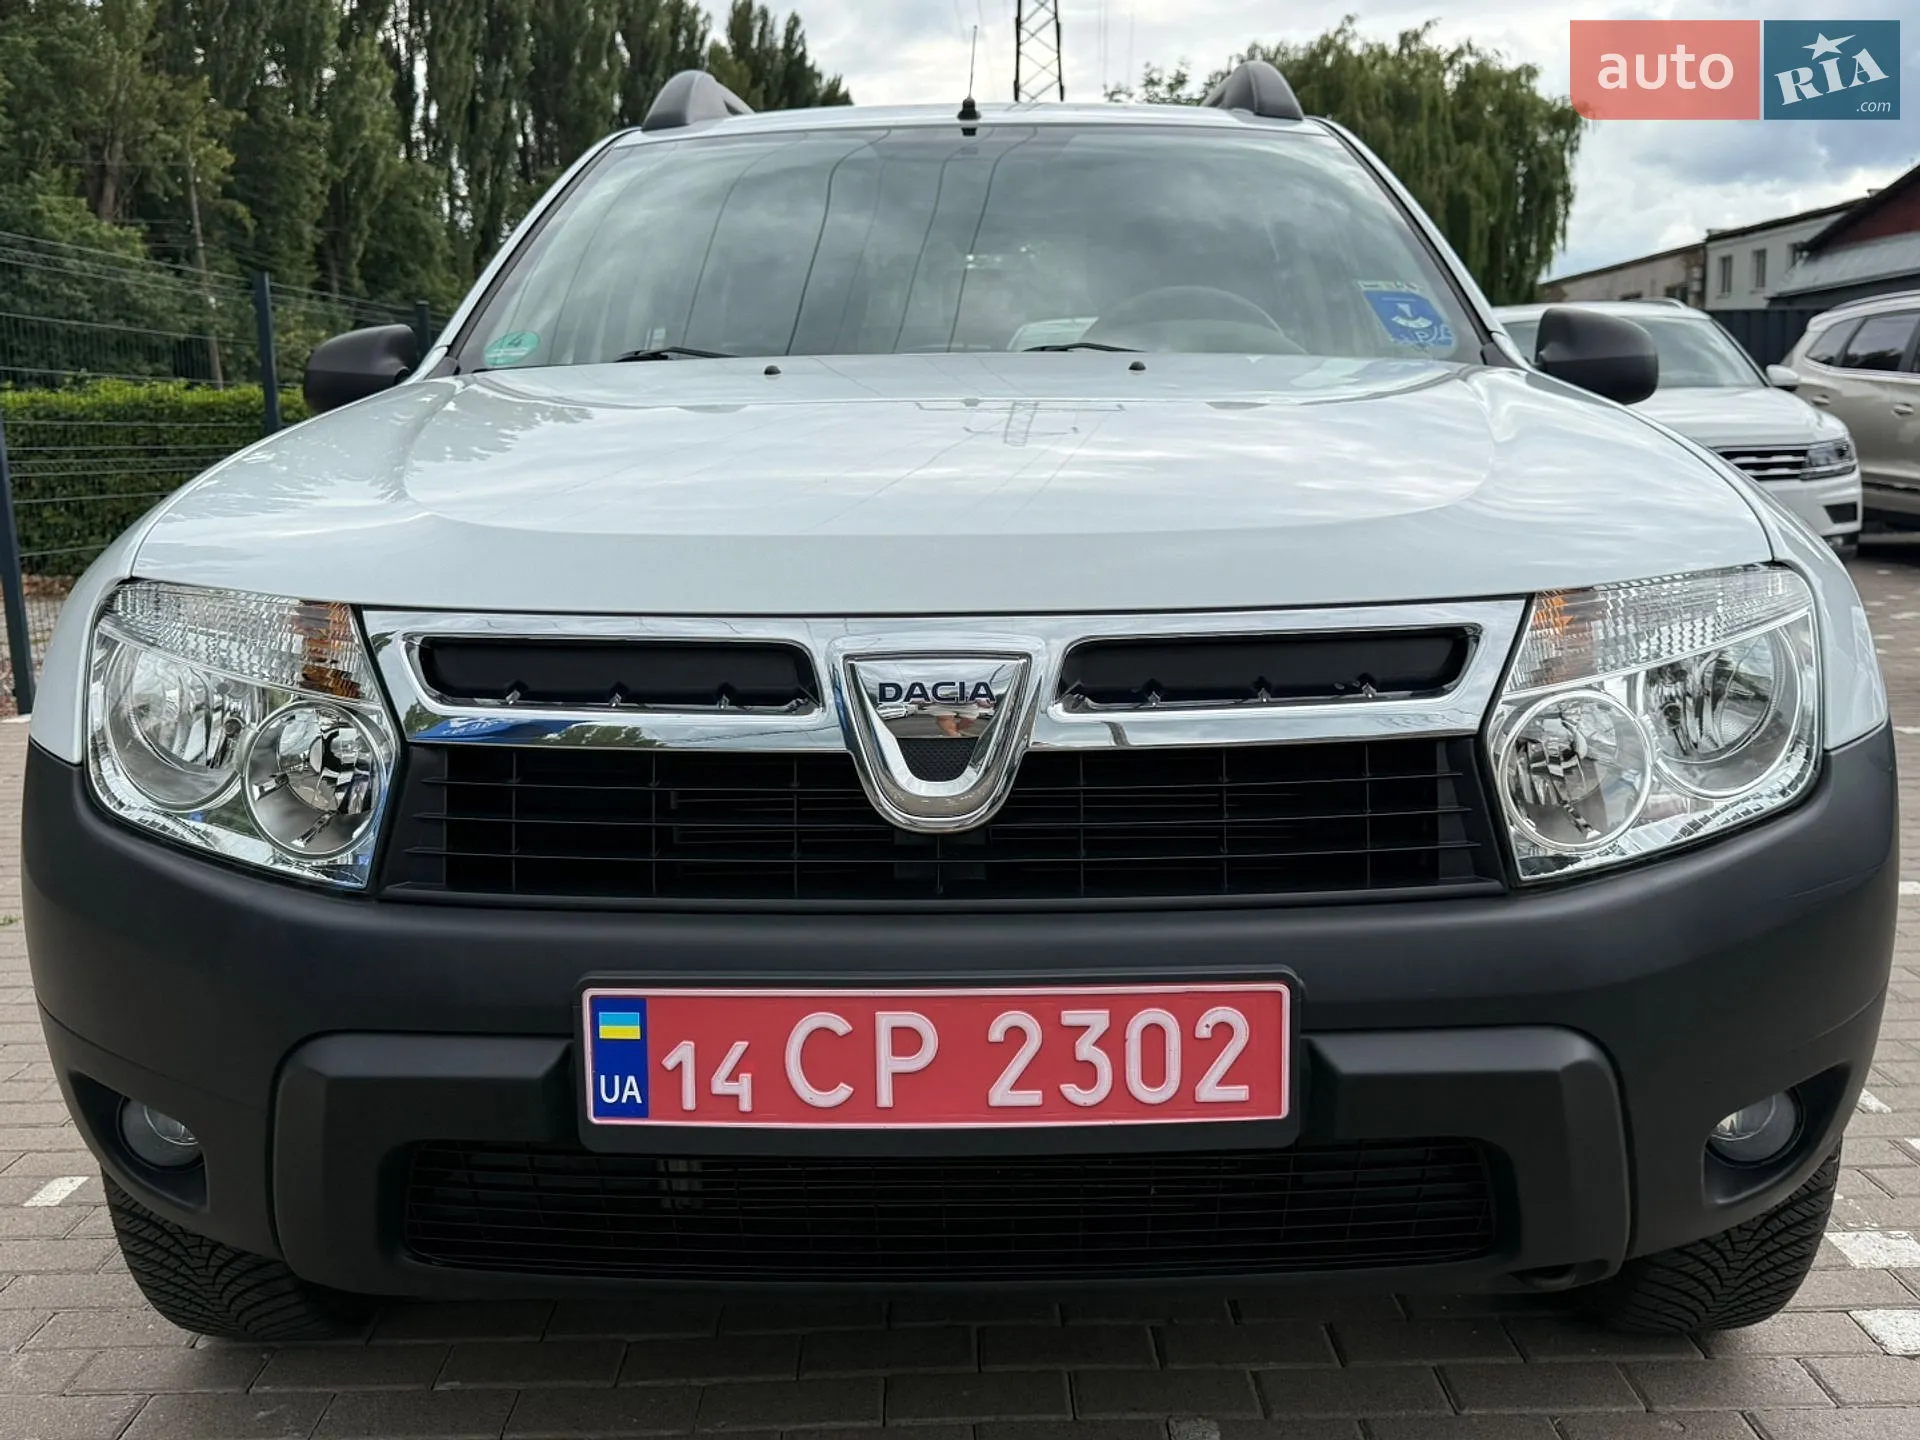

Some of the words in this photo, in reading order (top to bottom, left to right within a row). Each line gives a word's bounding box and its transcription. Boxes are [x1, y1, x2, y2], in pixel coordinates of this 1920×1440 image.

[878, 681, 996, 703] DACIA
[662, 1041, 753, 1113] 14
[784, 1011, 938, 1108] CP
[988, 1006, 1250, 1107] 2302
[600, 1075, 642, 1105] UA
